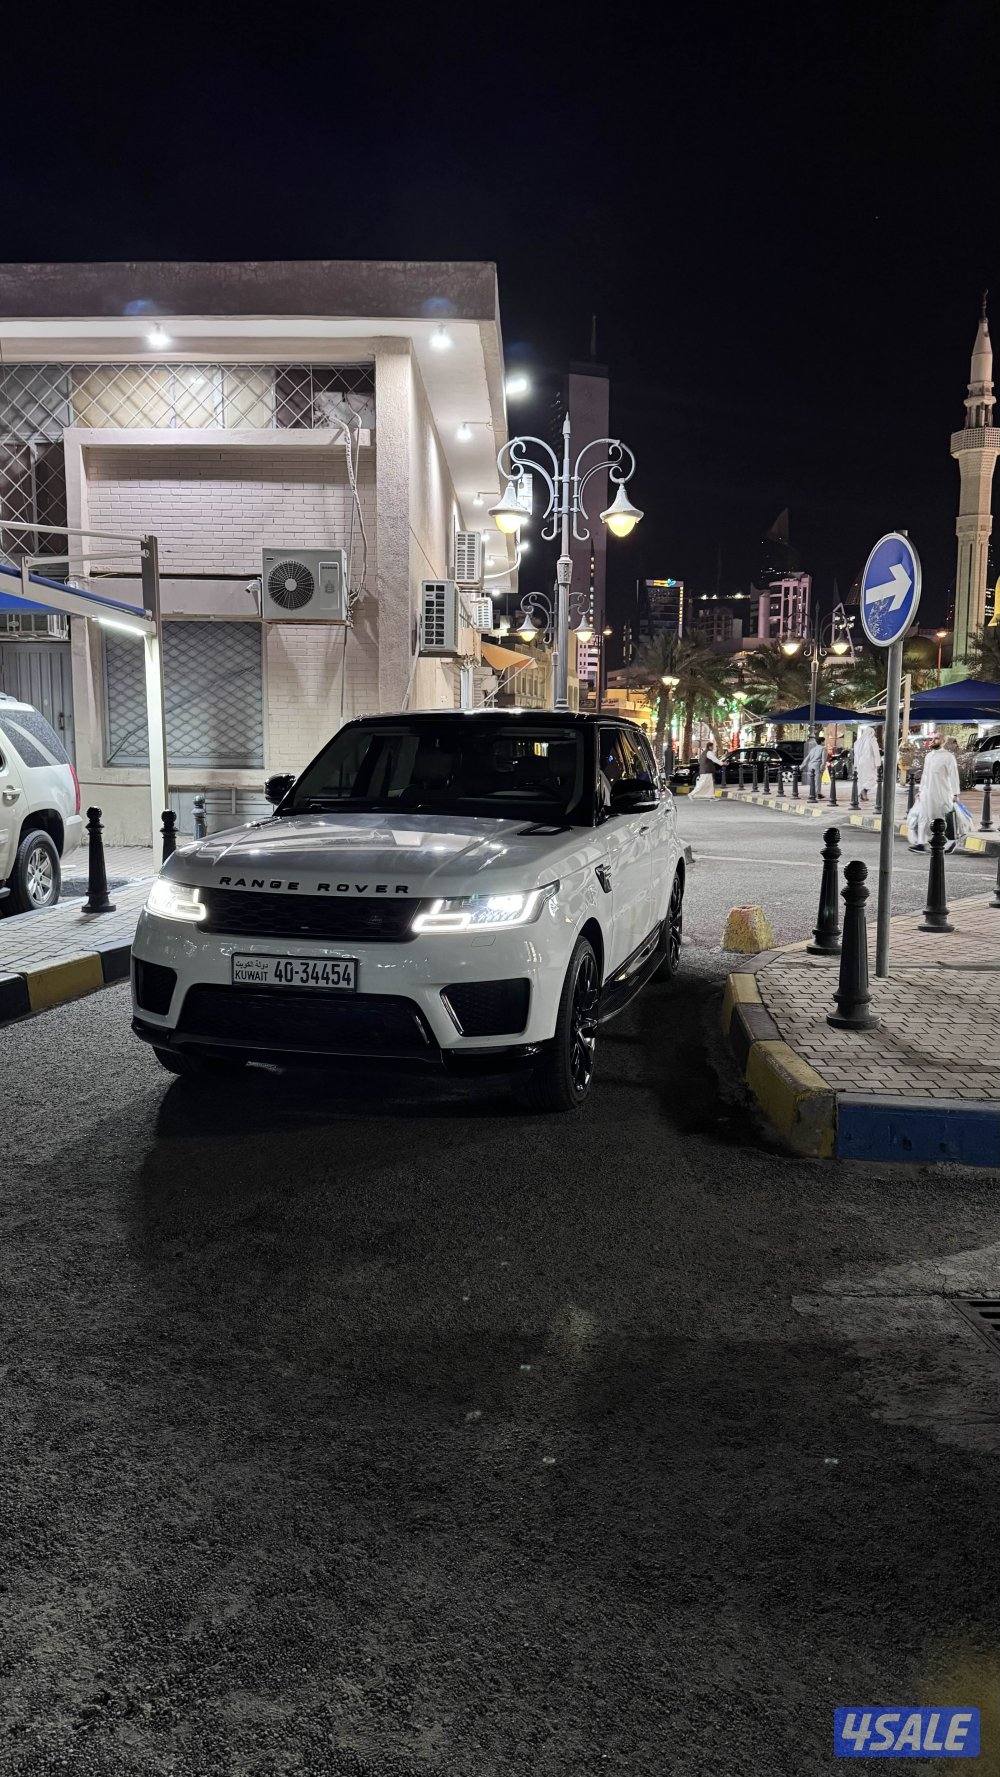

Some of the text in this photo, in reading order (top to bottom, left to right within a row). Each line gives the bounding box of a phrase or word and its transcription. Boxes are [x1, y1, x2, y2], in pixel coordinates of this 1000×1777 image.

[219, 876, 409, 894] RANGE ROVER
[235, 970, 269, 982] KUWAIT
[274, 960, 352, 986] 40-34454
